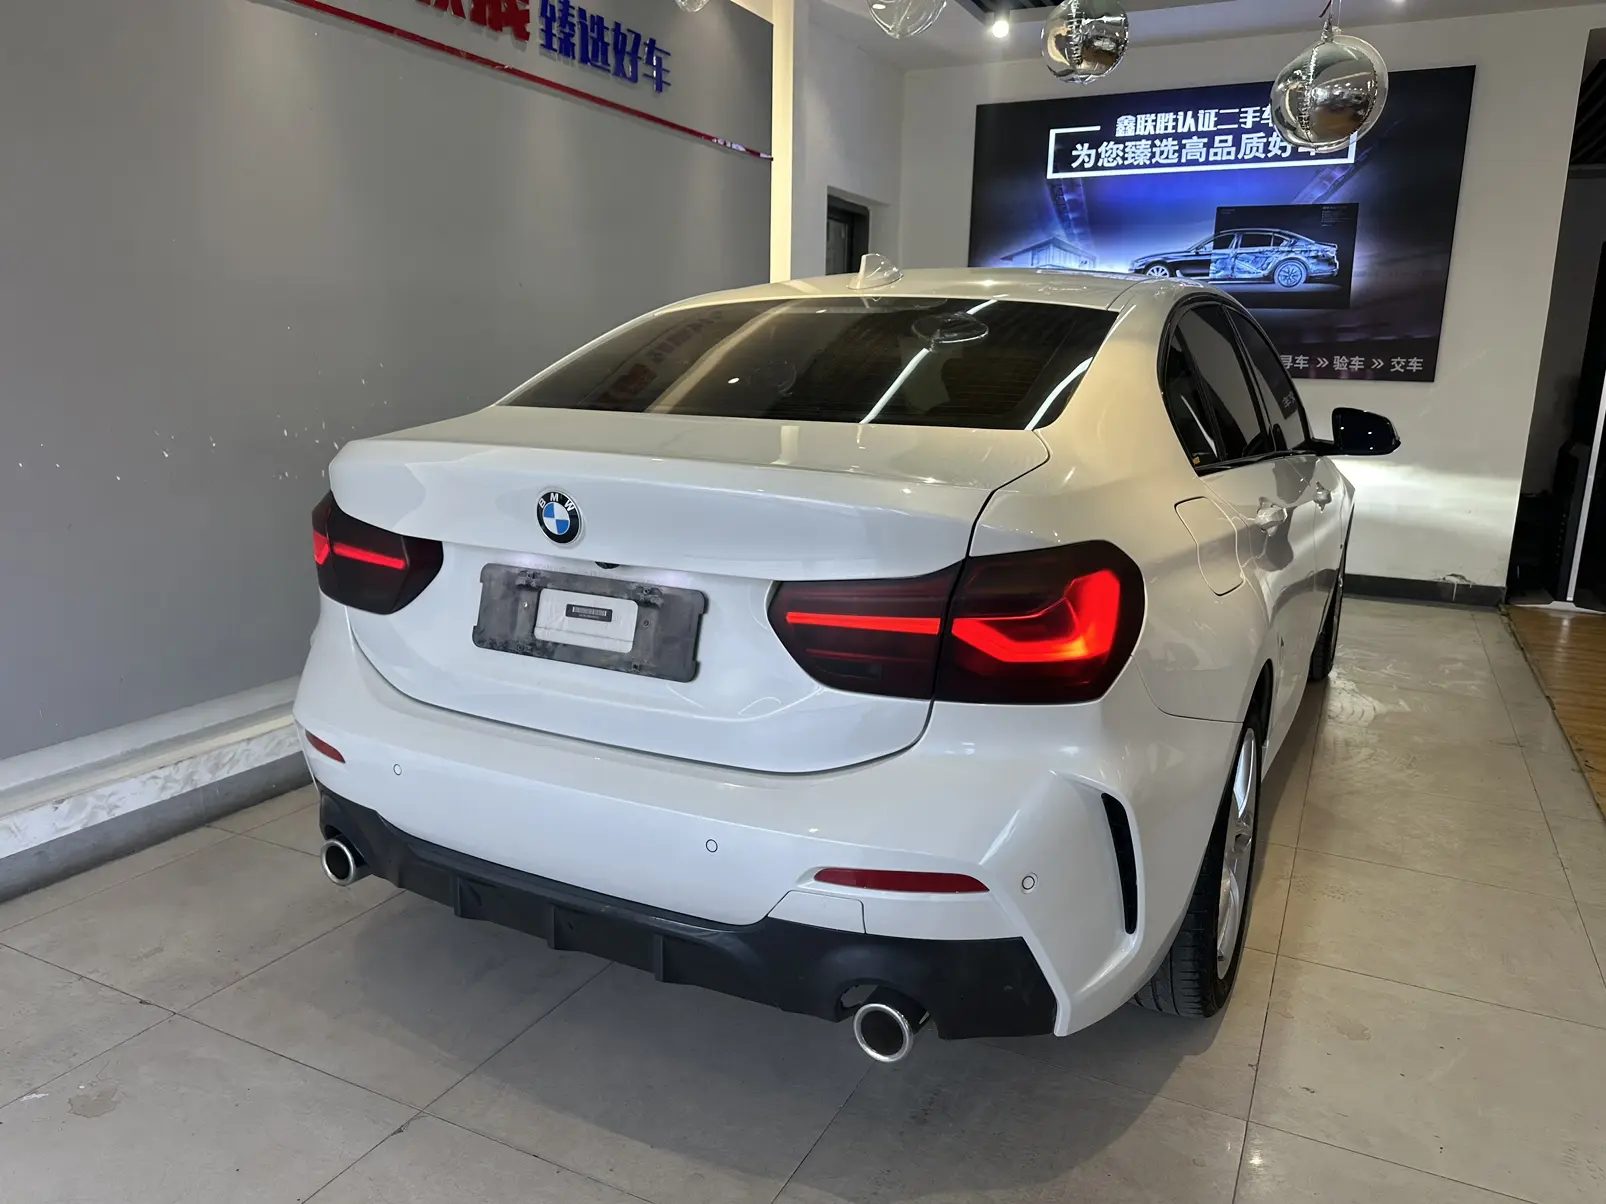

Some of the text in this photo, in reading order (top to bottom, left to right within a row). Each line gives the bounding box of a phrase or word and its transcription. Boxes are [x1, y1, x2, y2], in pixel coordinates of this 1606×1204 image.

[539, 0, 671, 92] 臻选好车
[1071, 131, 1316, 169] 为您臻选高品质好
[1333, 355, 1365, 371] 验车
[1390, 357, 1424, 372] 交车
[538, 492, 575, 512] BMW
